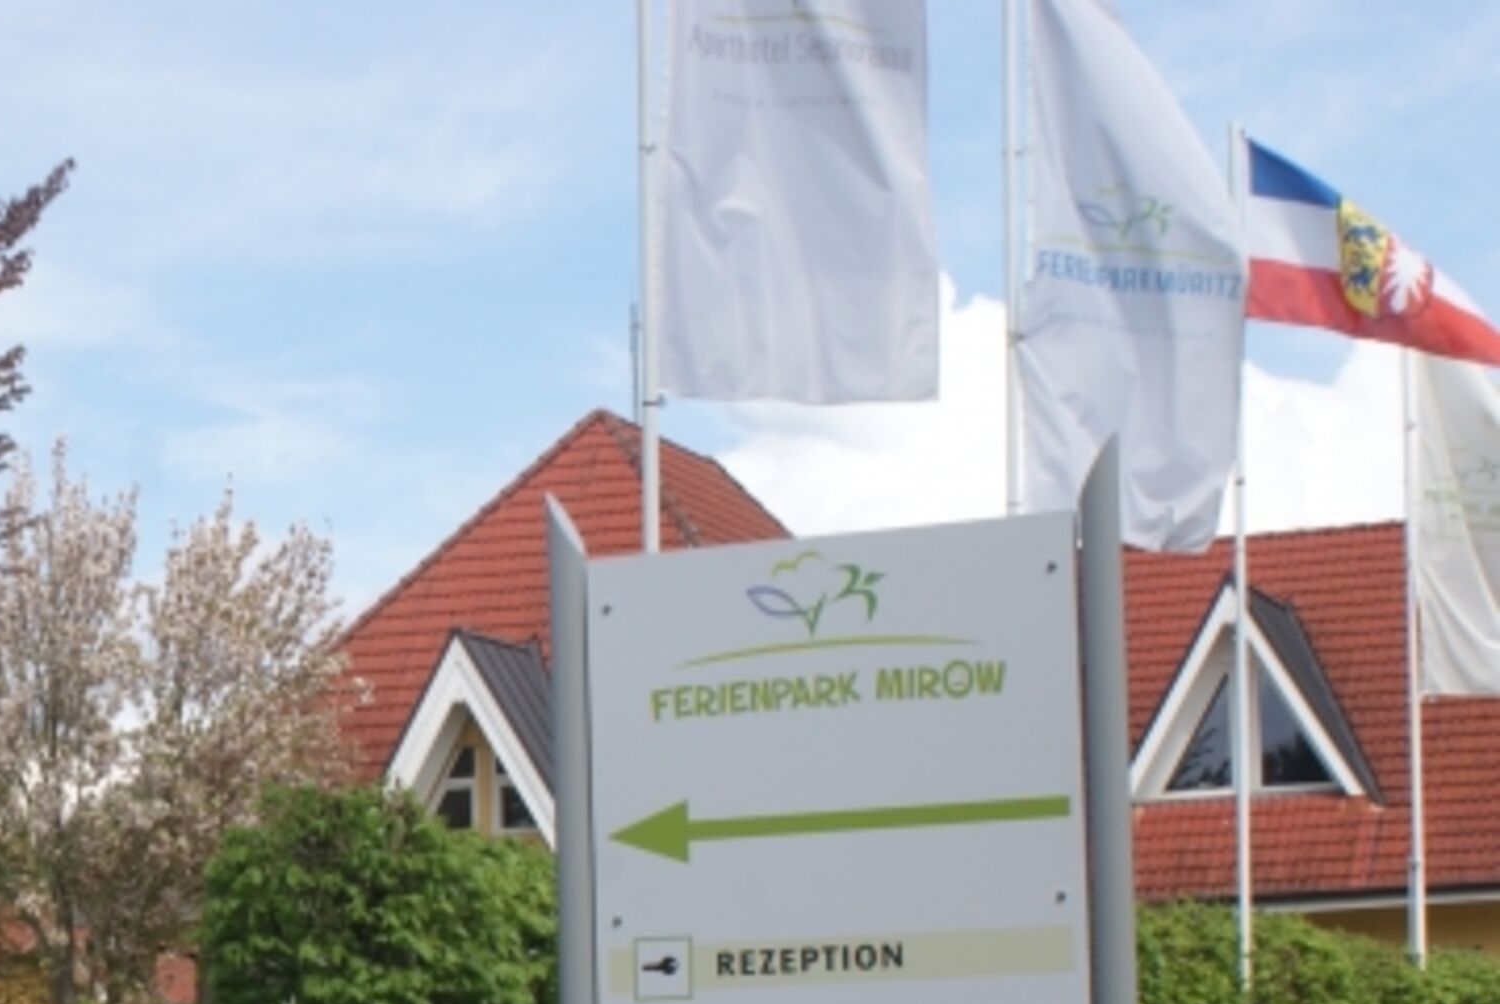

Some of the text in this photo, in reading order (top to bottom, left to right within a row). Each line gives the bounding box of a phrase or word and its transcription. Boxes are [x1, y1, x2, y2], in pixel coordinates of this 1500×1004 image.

[650, 660, 1006, 721] FERIENPARK MIROW
[715, 943, 905, 976] REZEPTION
